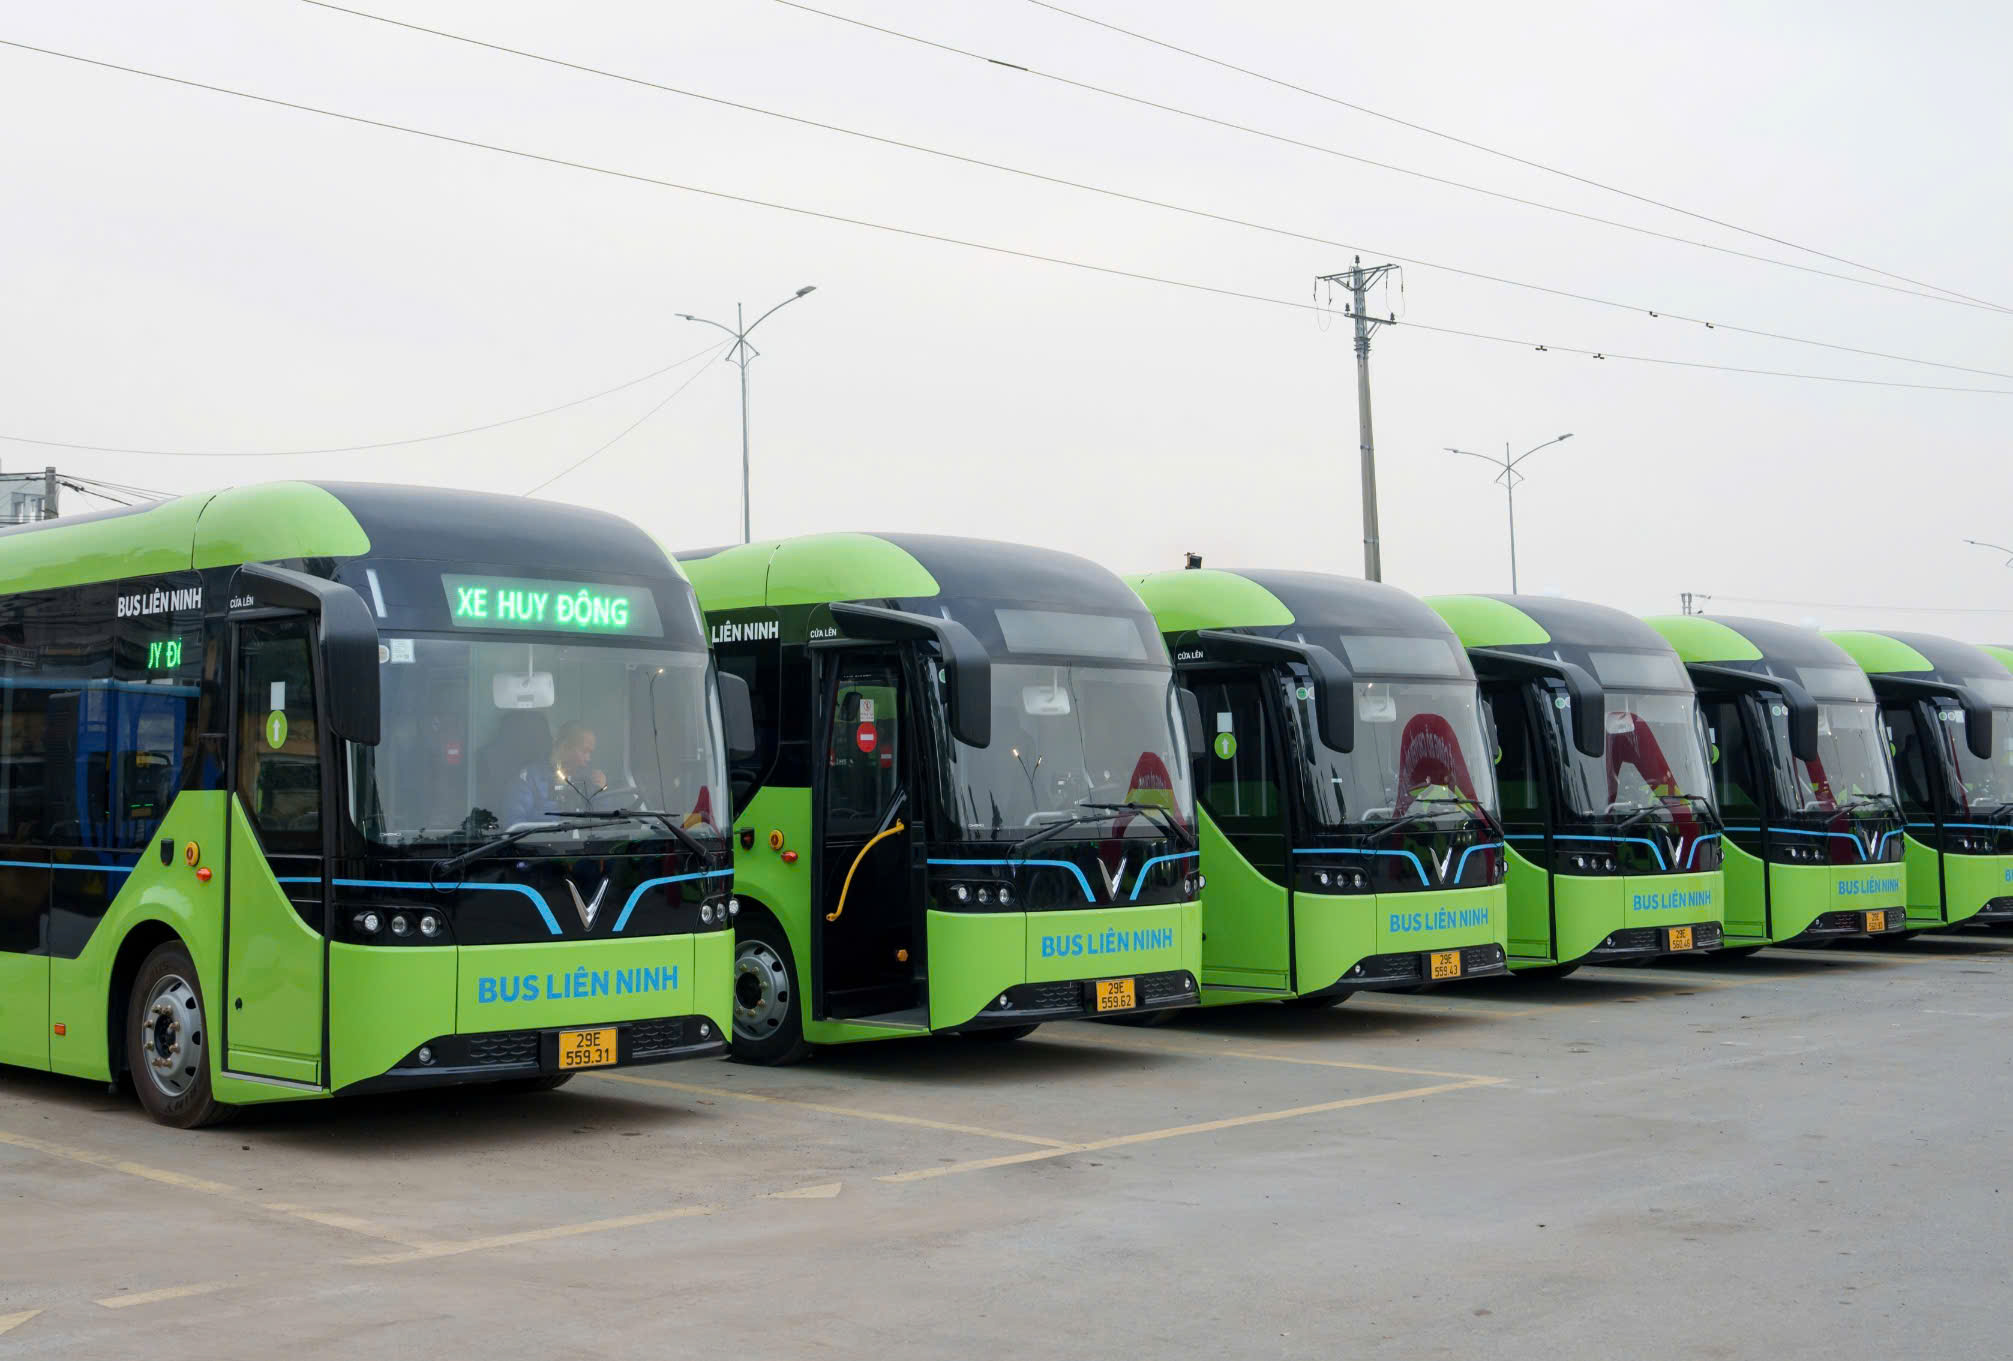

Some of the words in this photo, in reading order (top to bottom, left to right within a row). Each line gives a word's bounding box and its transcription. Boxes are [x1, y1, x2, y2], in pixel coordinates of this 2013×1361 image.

[117, 596, 141, 617] BUS
[142, 588, 169, 615] LIÊN
[170, 587, 202, 611] NINH
[457, 586, 488, 618] XE
[497, 590, 549, 622] HUY
[712, 620, 741, 643] LIÊN
[744, 621, 778, 641] NINH
[824, 627, 837, 637] LÊN
[1839, 880, 1859, 896] BUS
[1633, 893, 1659, 911] BUS
[1661, 888, 1687, 909] LIÊN
[1687, 889, 1711, 907] NINH
[1389, 912, 1422, 933] BUS
[1424, 906, 1457, 930] LIÊN
[1459, 906, 1489, 928] NINH
[1041, 935, 1083, 958] BUS
[1087, 927, 1129, 955] LIÊN
[1133, 927, 1173, 952] NINH
[1439, 953, 1453, 966] 29E
[478, 974, 540, 1004] BUS
[546, 965, 609, 1000] LIÊN
[615, 965, 679, 995] NINH
[1108, 982, 1125, 995] 29E
[1101, 995, 1132, 1009] 559.62
[576, 1032, 601, 1049] 29E
[566, 1049, 610, 1066] 559.31
